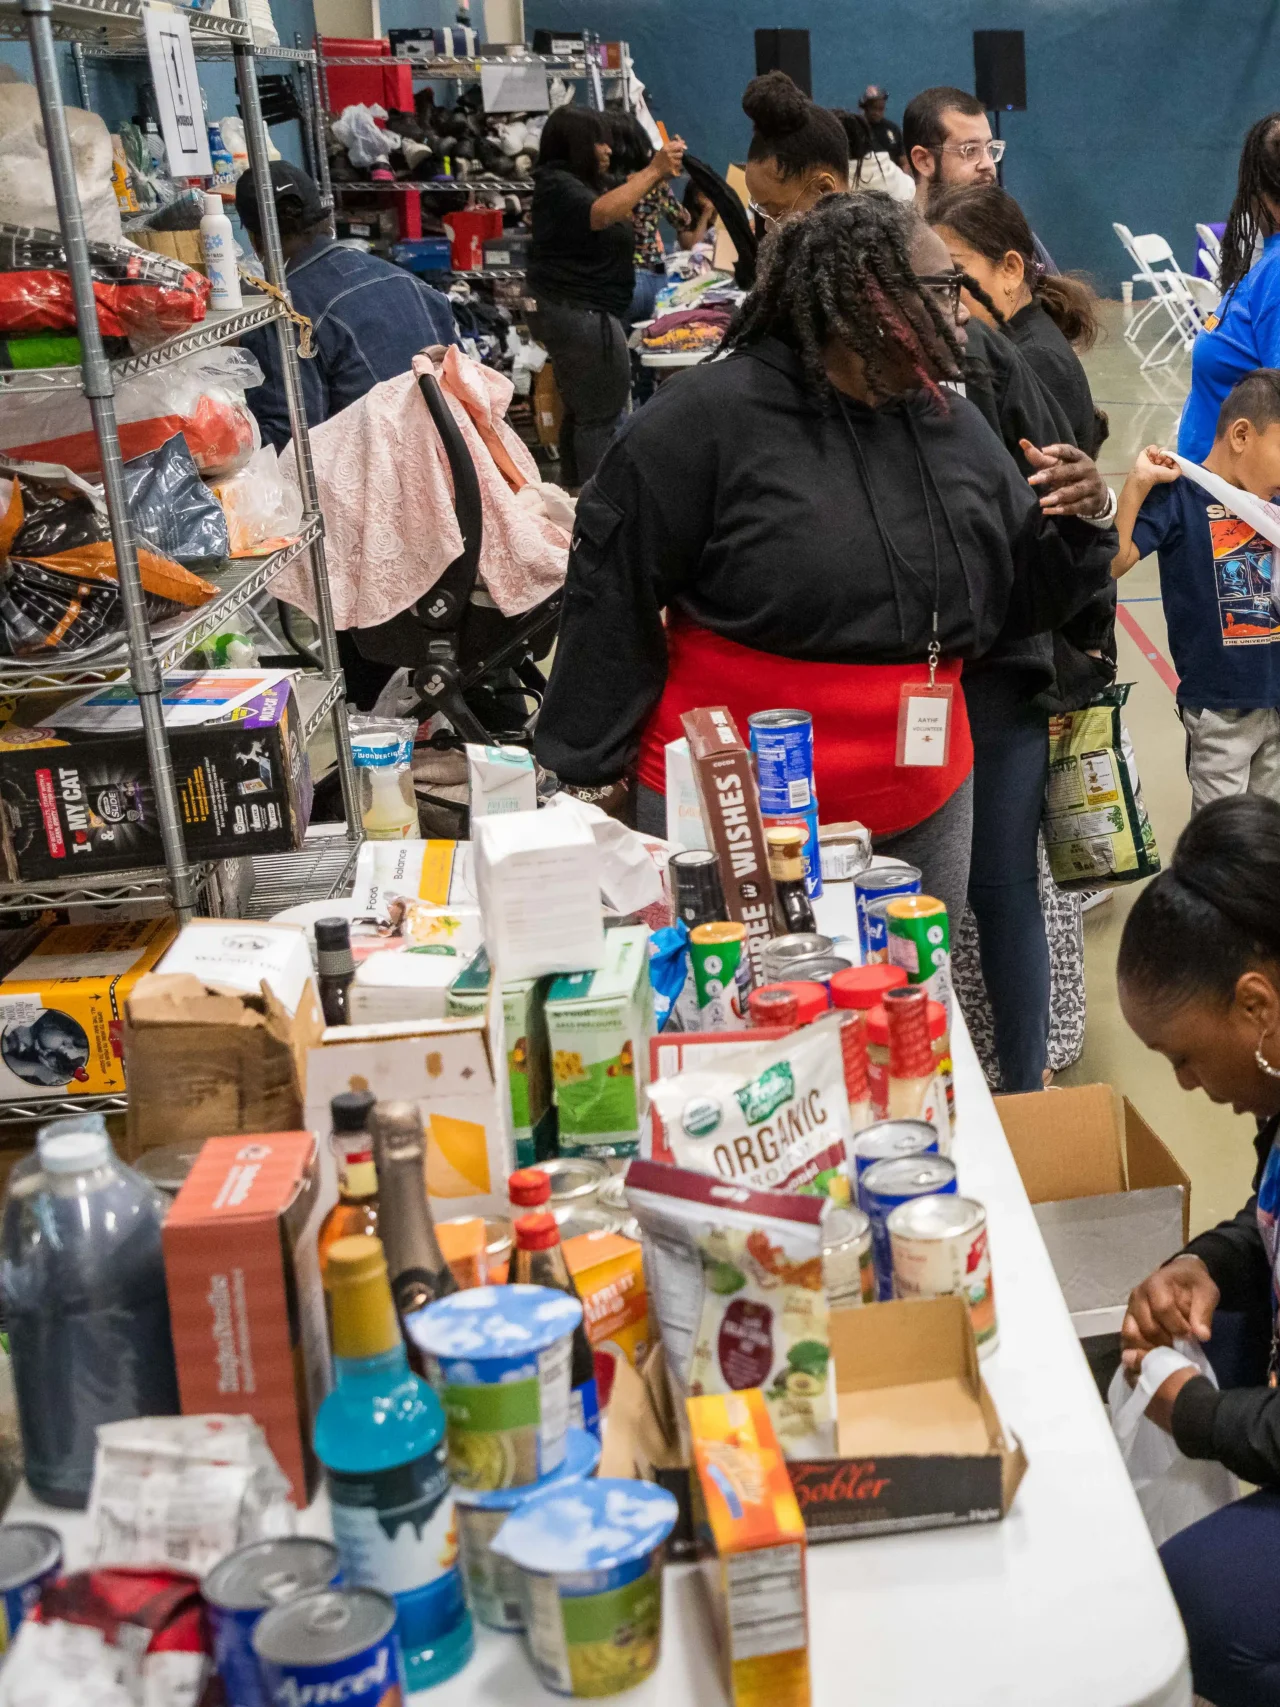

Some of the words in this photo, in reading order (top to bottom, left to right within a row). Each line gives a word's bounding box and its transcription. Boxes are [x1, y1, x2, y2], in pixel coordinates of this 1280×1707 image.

[58, 768, 83, 801] CAT
[66, 803, 87, 831] MY
[109, 791, 120, 818] SLIDE
[101, 830, 114, 841] &
[715, 773, 758, 878] WISHES
[72, 841, 92, 854] I
[393, 849, 407, 880] Balance
[366, 886, 379, 910] Food
[714, 1088, 827, 1178] ORGANIC
[275, 1646, 389, 1707] Ancel
